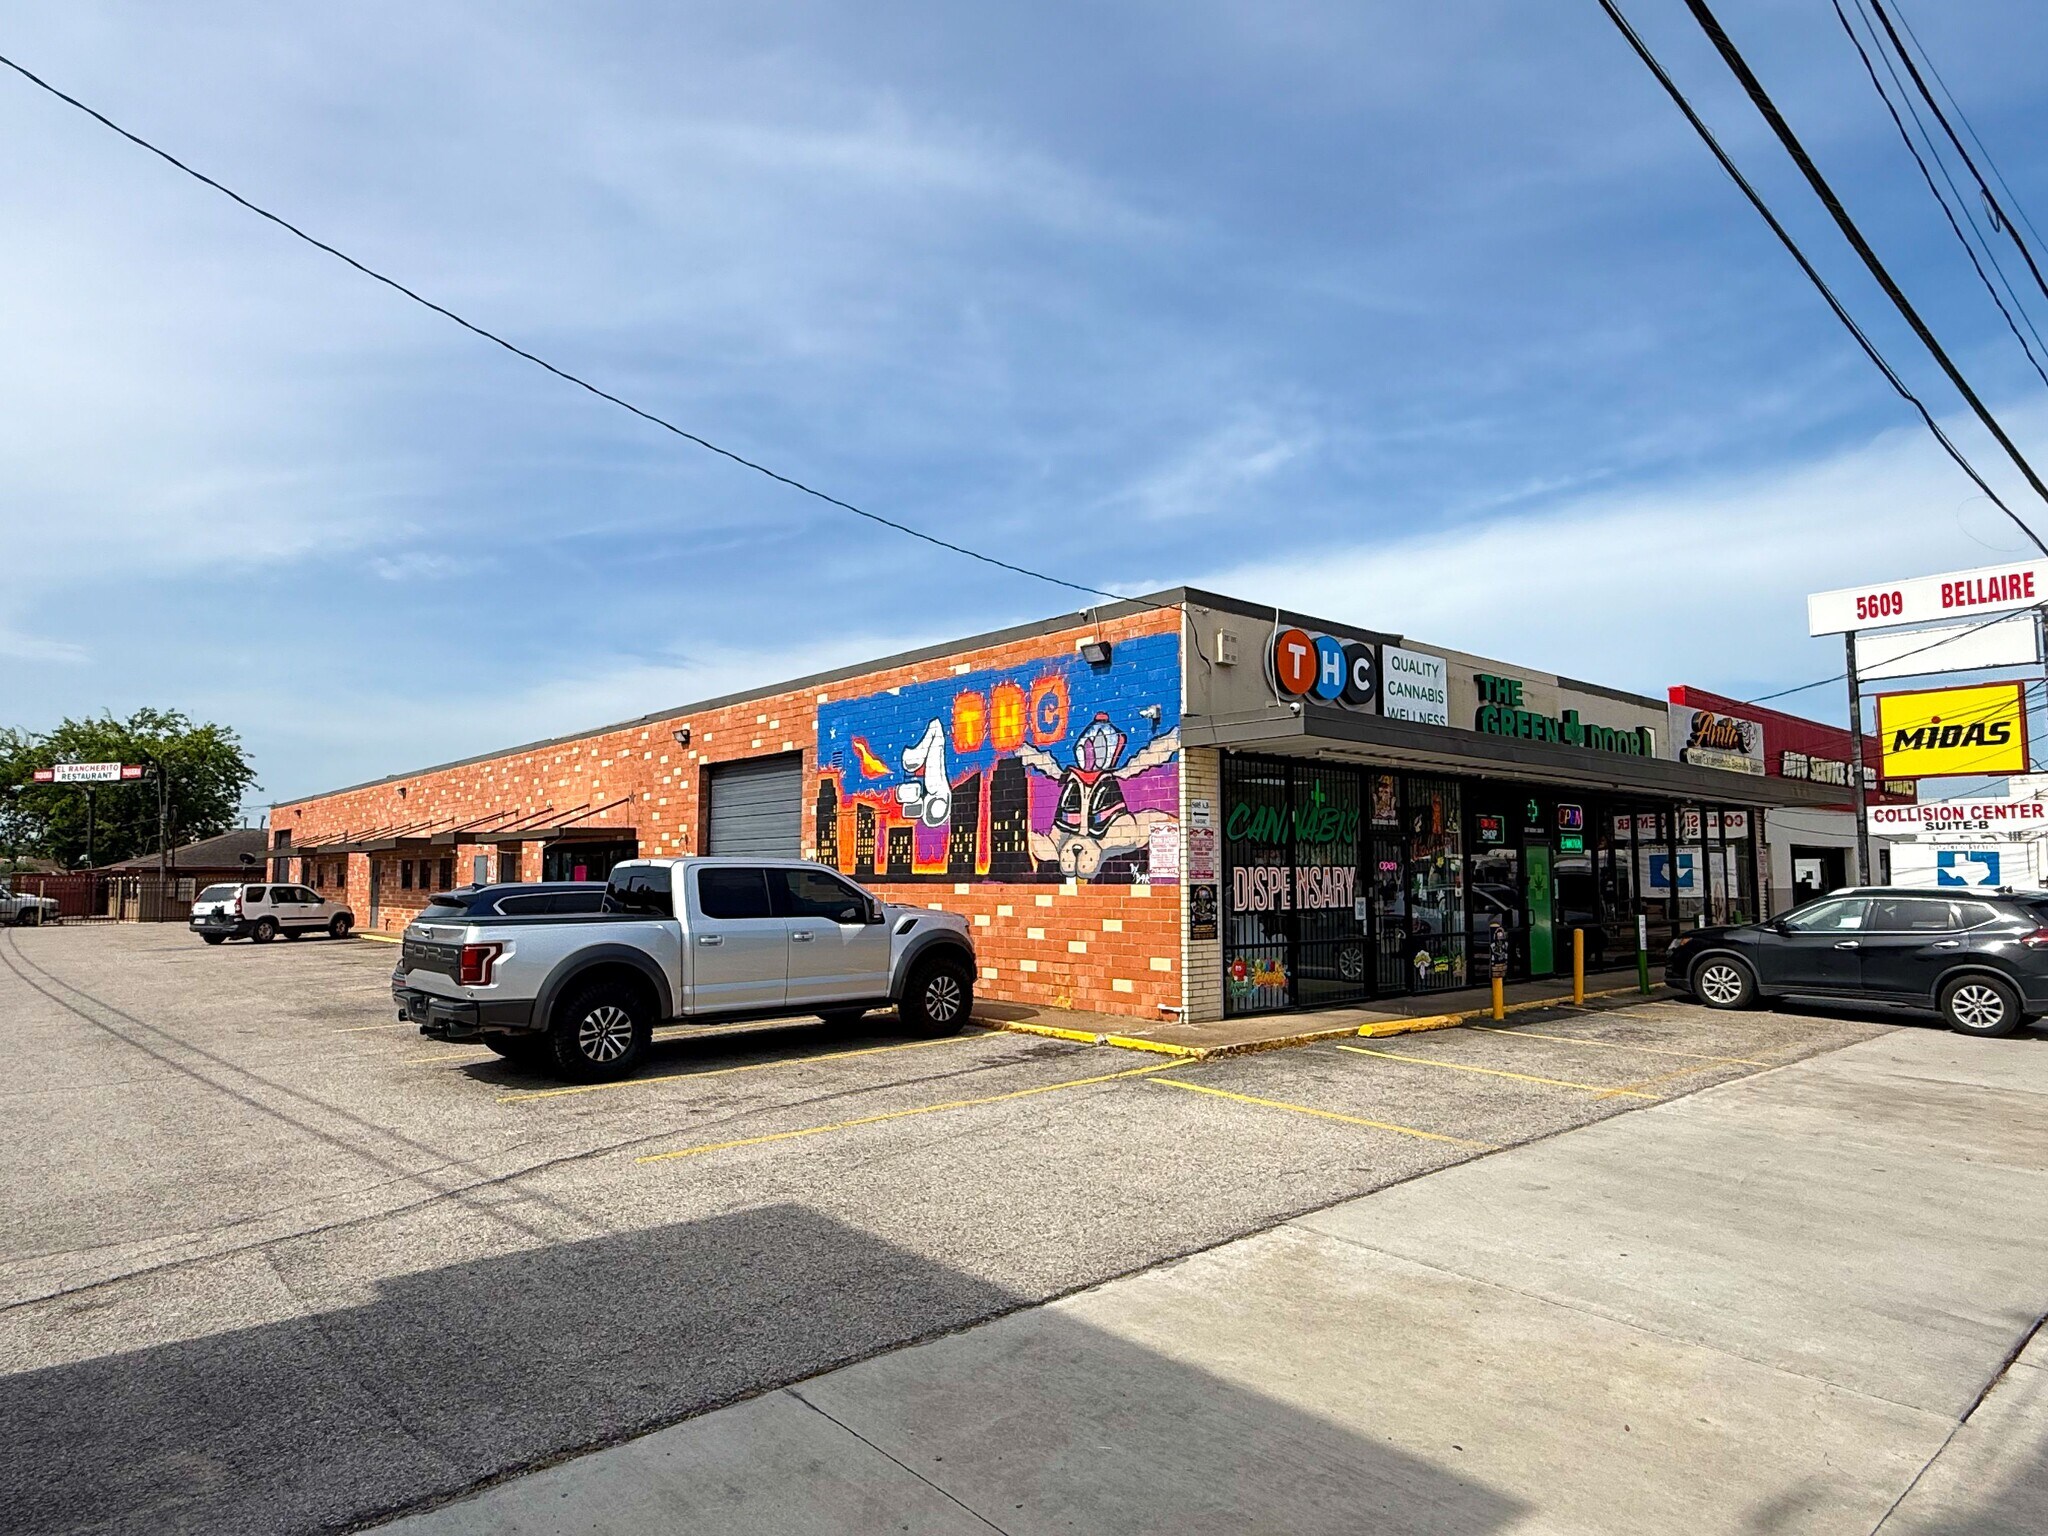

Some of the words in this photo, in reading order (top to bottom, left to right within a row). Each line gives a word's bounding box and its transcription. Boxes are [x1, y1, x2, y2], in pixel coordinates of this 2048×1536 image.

[1856, 591, 1903, 620] 5609
[1941, 571, 2035, 609] BELLAIRE
[1288, 643, 1370, 691] THC
[1391, 655, 1439, 678] QUALITY
[1388, 681, 1444, 704] CANNABIS
[1478, 673, 1524, 706] THE
[960, 691, 1060, 745] THC
[1479, 705, 1560, 744] GREEN
[1590, 724, 1641, 757] DOOR
[1892, 716, 2012, 752] MIDAS
[61, 772, 113, 780] RESTAURANT
[68, 764, 119, 773] RANCHERITO
[1782, 751, 1808, 779] AUTO
[1810, 756, 1846, 786] SERVICE
[1559, 808, 1581, 825] OPEN
[1874, 806, 1964, 823] COLLISION
[1970, 804, 2045, 821] CENTER
[1925, 820, 1990, 831] SUITE-B
[1233, 866, 1357, 912] DISPENSARY
[405, 943, 459, 962] FORD
